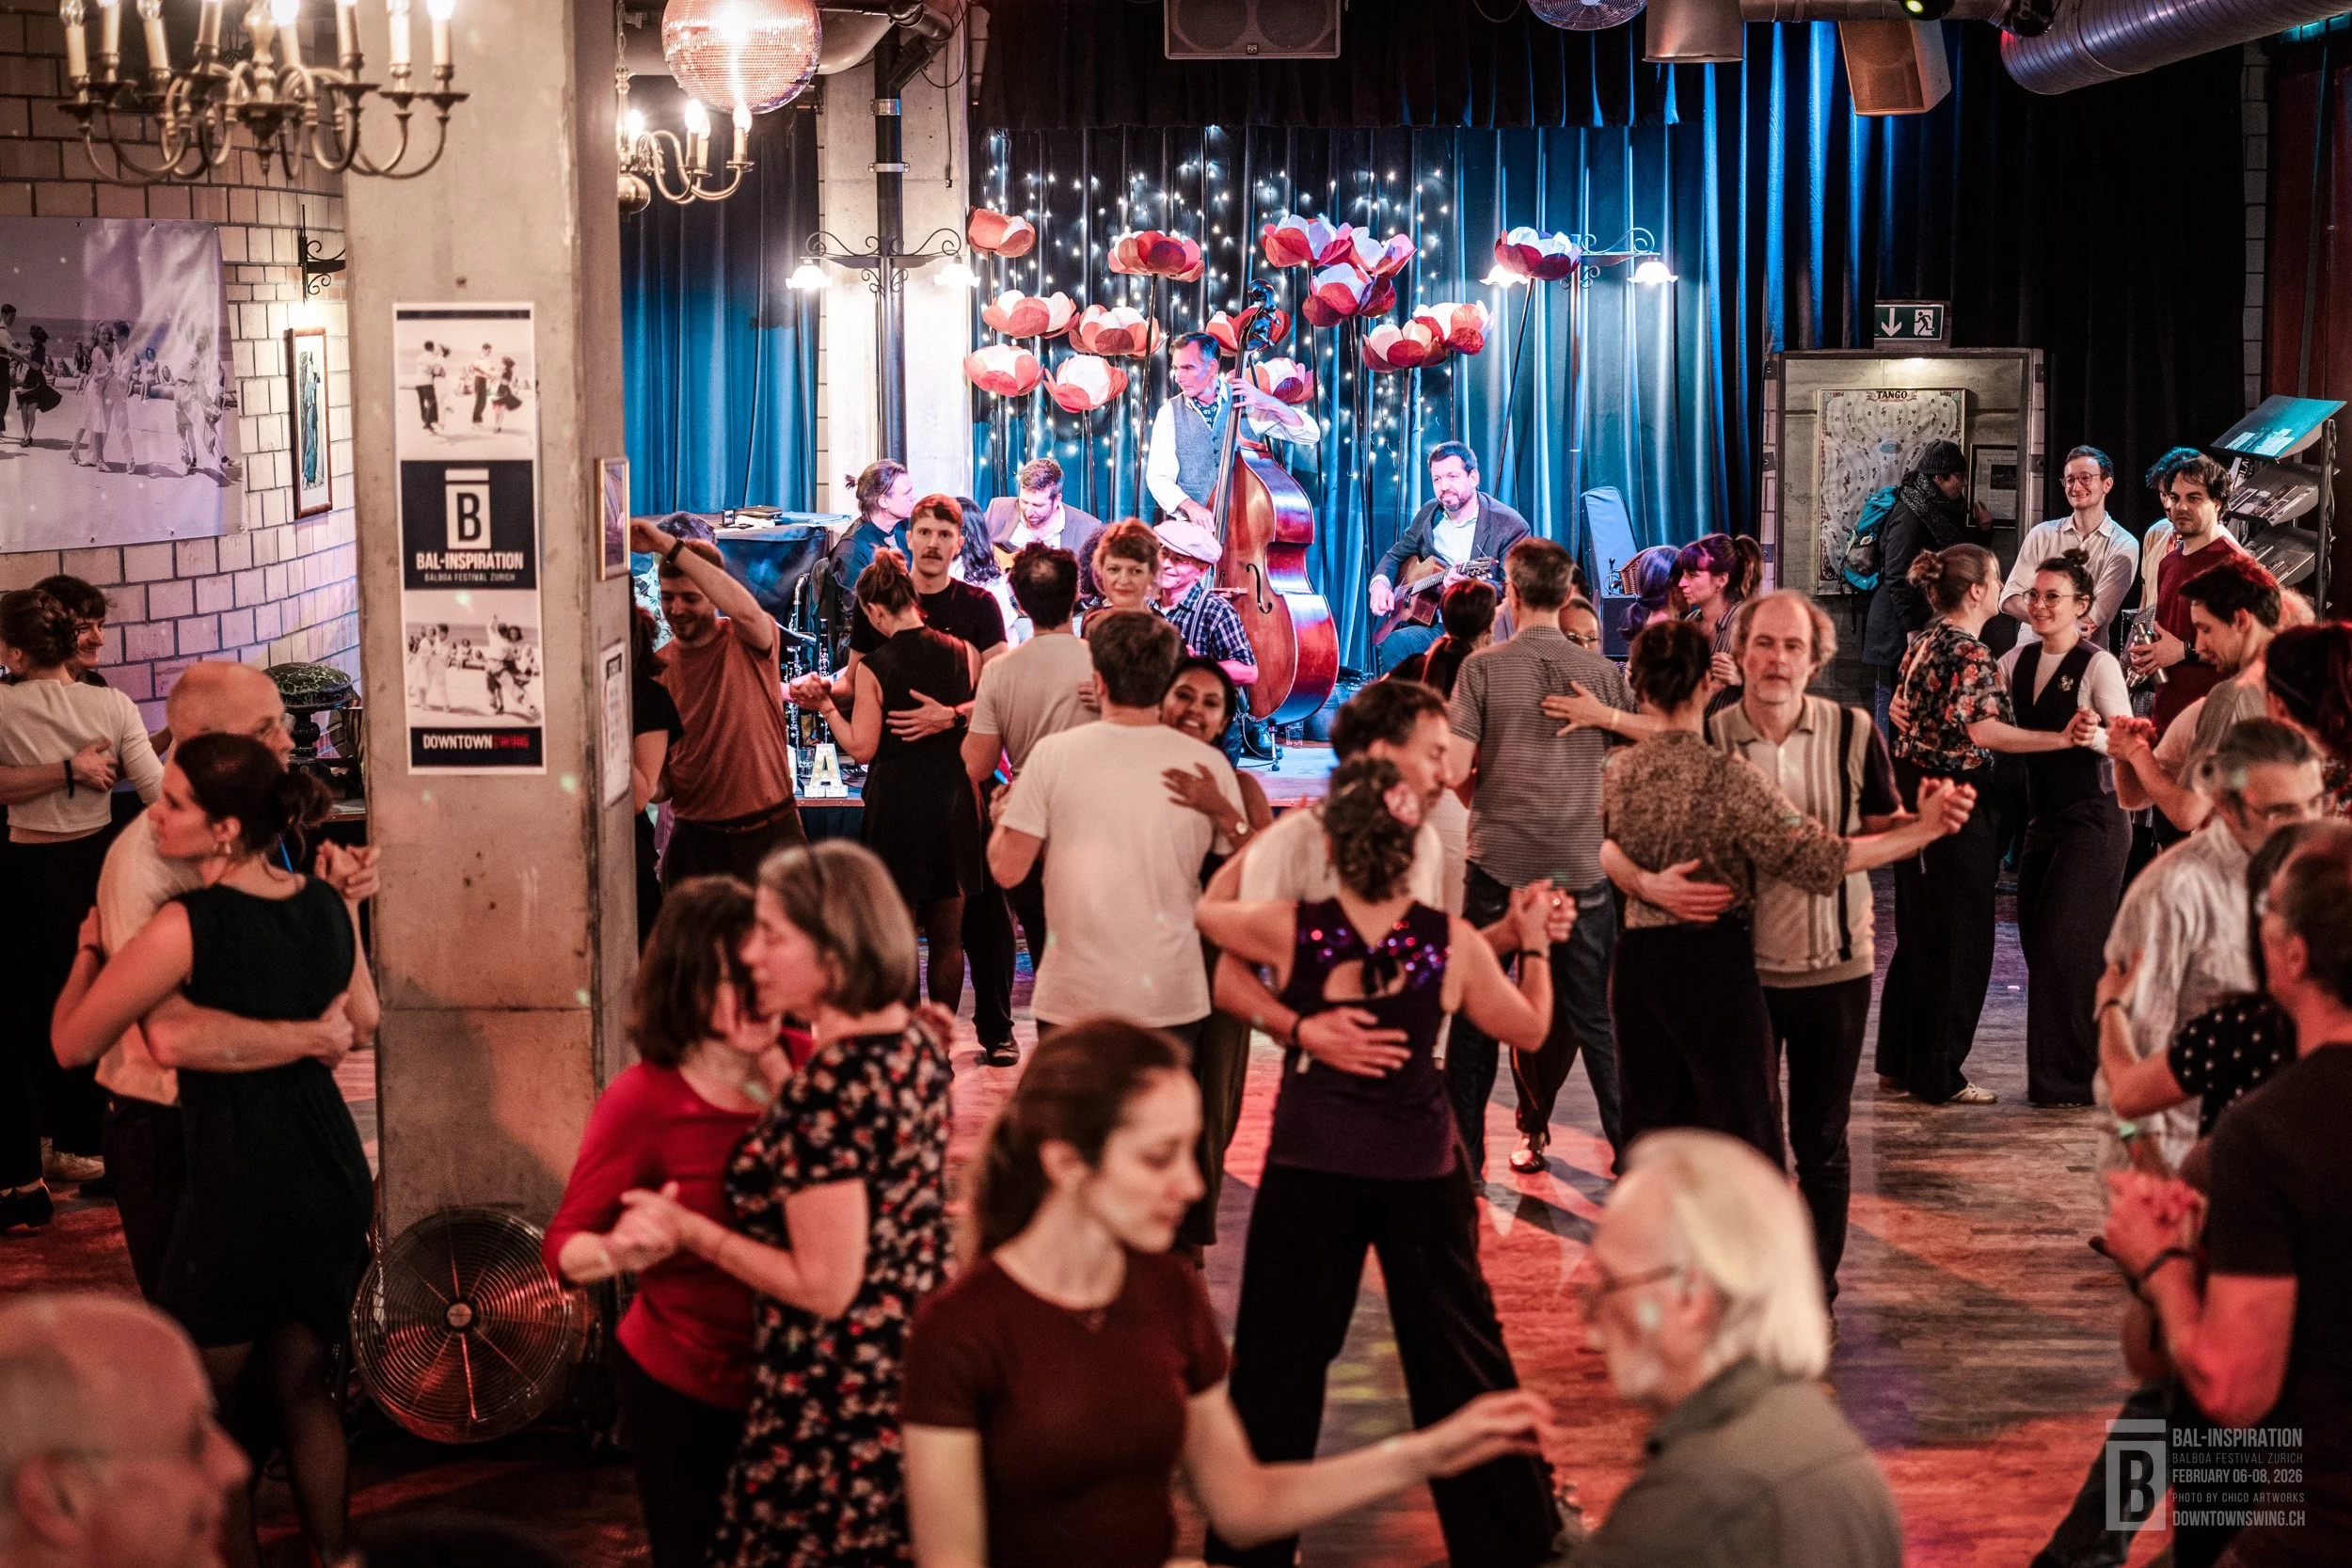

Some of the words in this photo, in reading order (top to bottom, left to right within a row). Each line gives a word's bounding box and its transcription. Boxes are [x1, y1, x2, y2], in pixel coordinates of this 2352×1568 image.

[1876, 390, 1908, 399] TANGO
[456, 492, 481, 543] B
[416, 552, 524, 570] BAL-INSPIRATION
[424, 573, 453, 582] BALBOA
[454, 572, 487, 582] FESTIVAL
[490, 572, 516, 581] ZURICH
[803, 743, 849, 798] A
